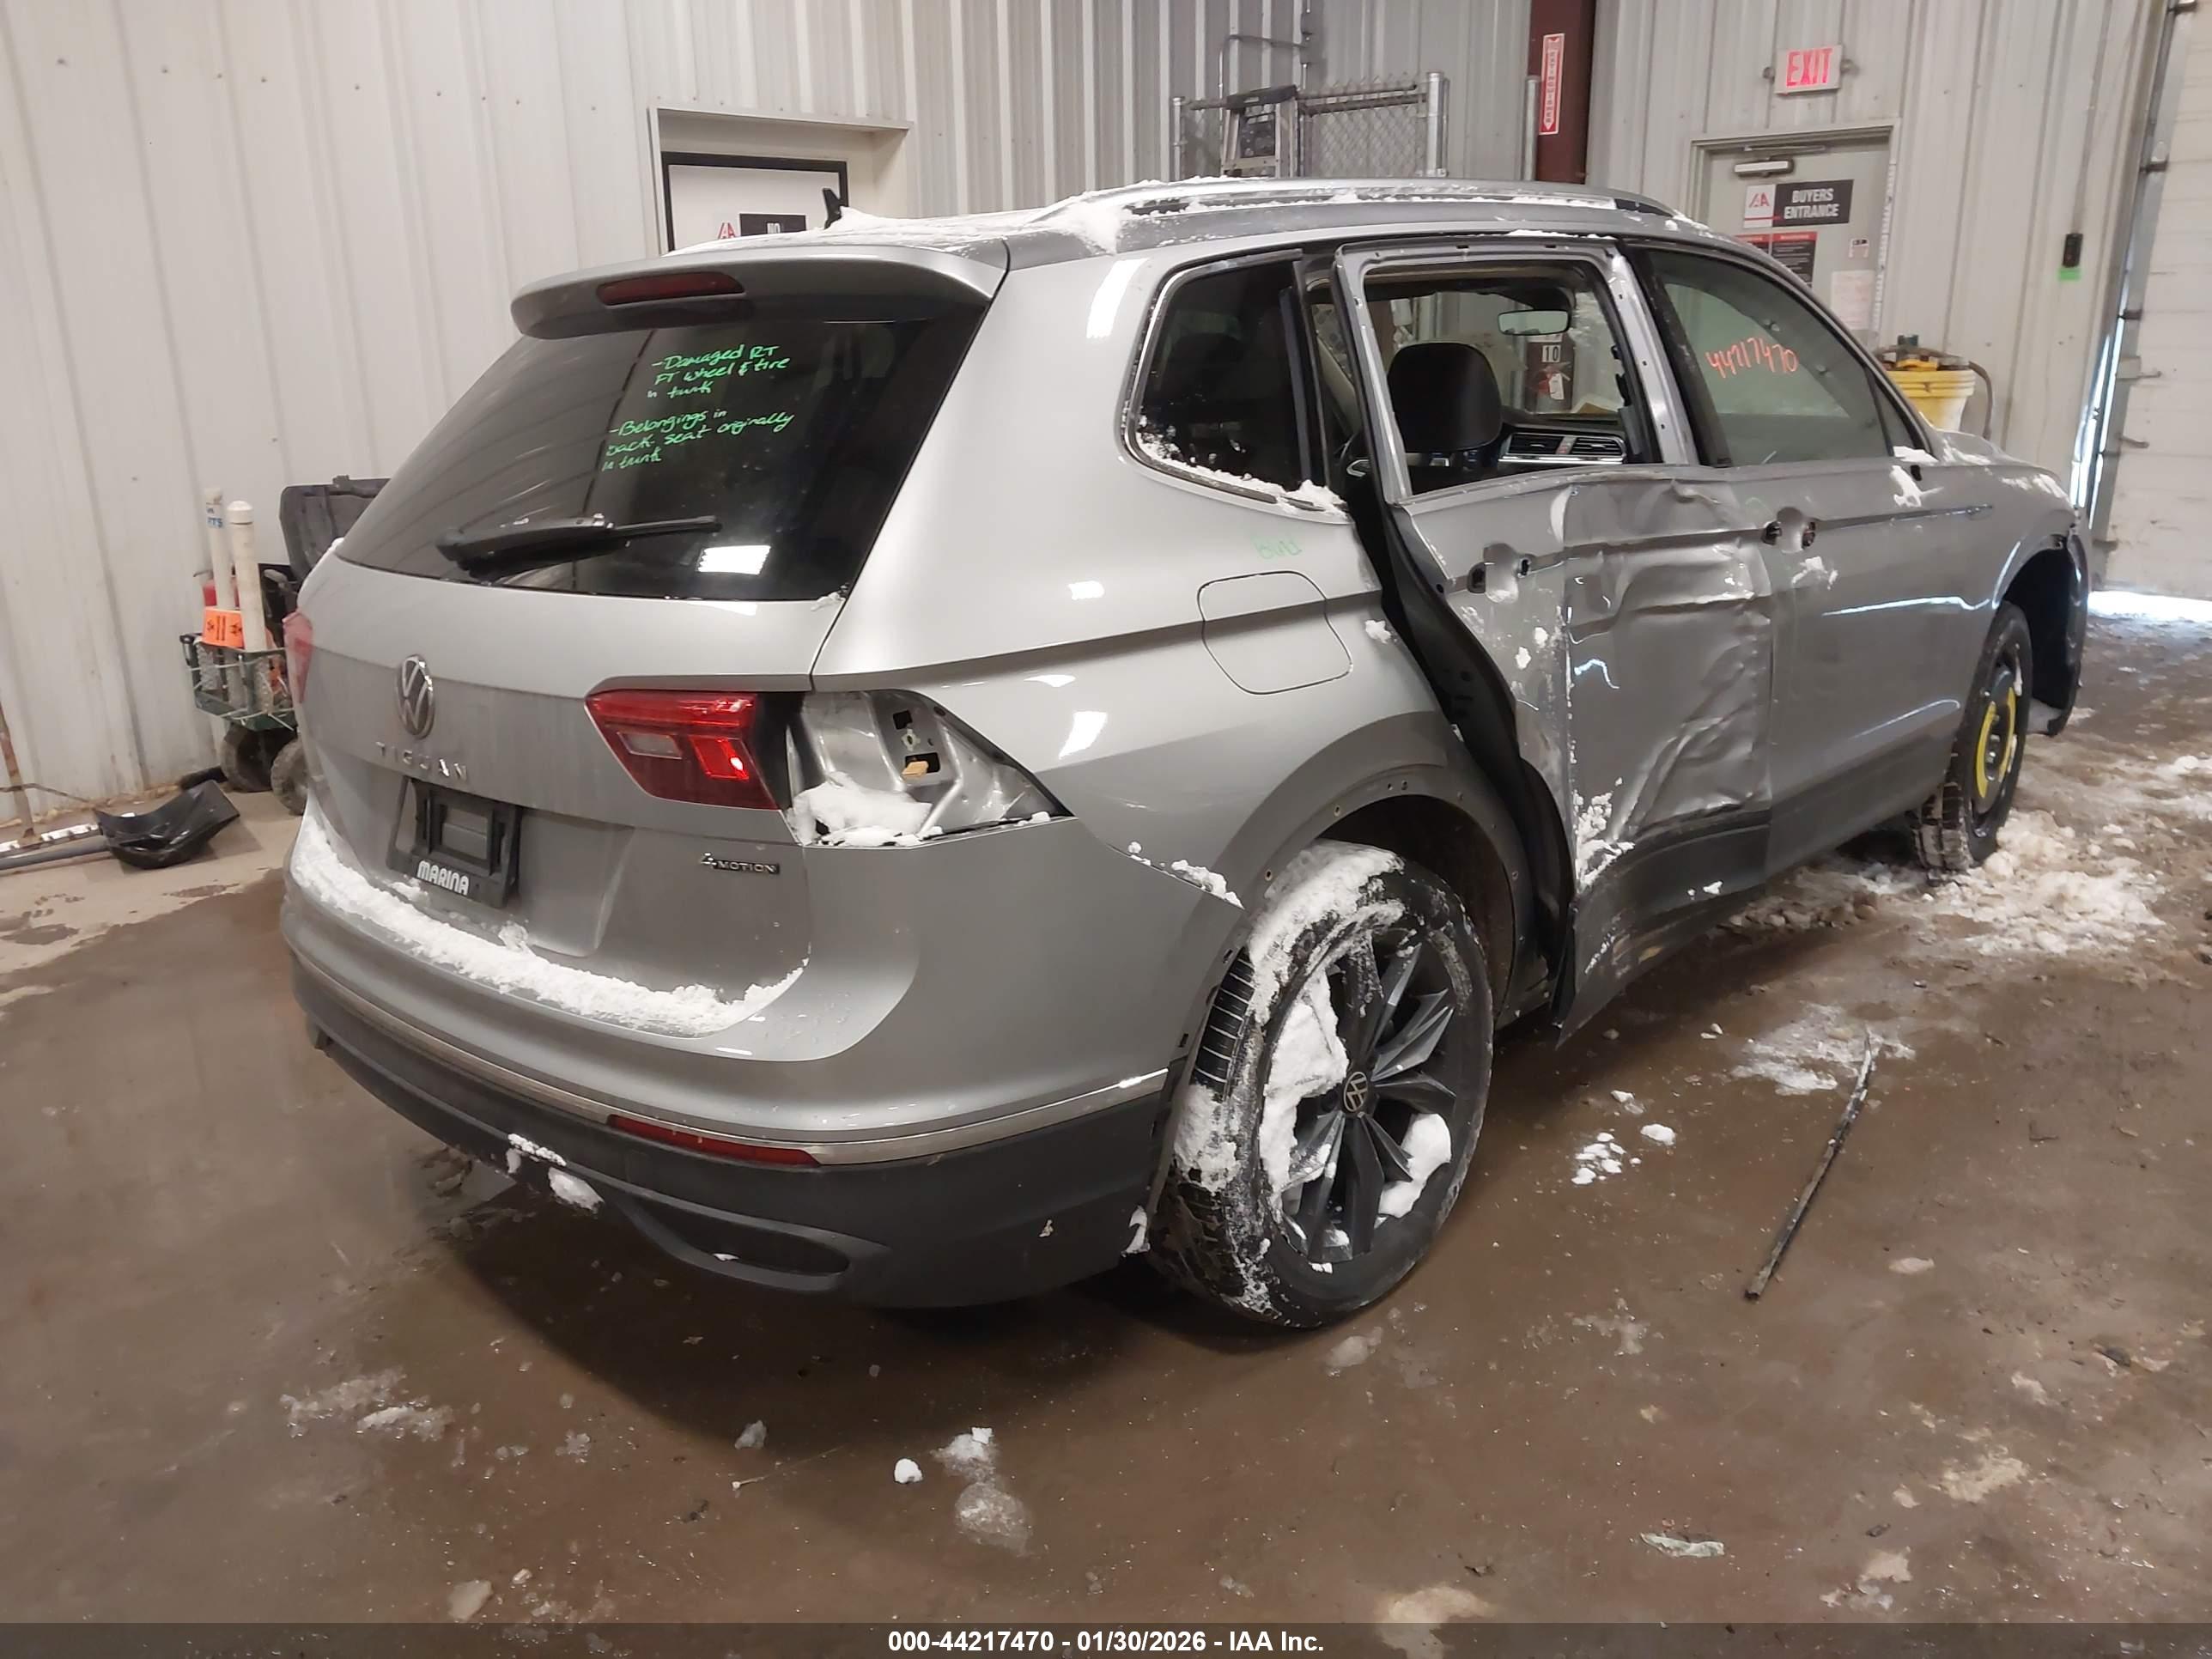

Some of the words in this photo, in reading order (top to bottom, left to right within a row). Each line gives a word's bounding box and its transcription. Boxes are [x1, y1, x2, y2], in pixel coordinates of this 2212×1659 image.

[1786, 48, 1832, 87] EXIT
[1791, 188, 1835, 204] BUYERS
[1784, 203, 1840, 220] ENTRANCE
[749, 345, 780, 360] RT
[1545, 345, 1559, 362] 10
[654, 370, 681, 386] FT
[753, 357, 791, 372] tire
[713, 408, 727, 418] in
[716, 411, 795, 435] originally
[416, 860, 470, 896] MARINA
